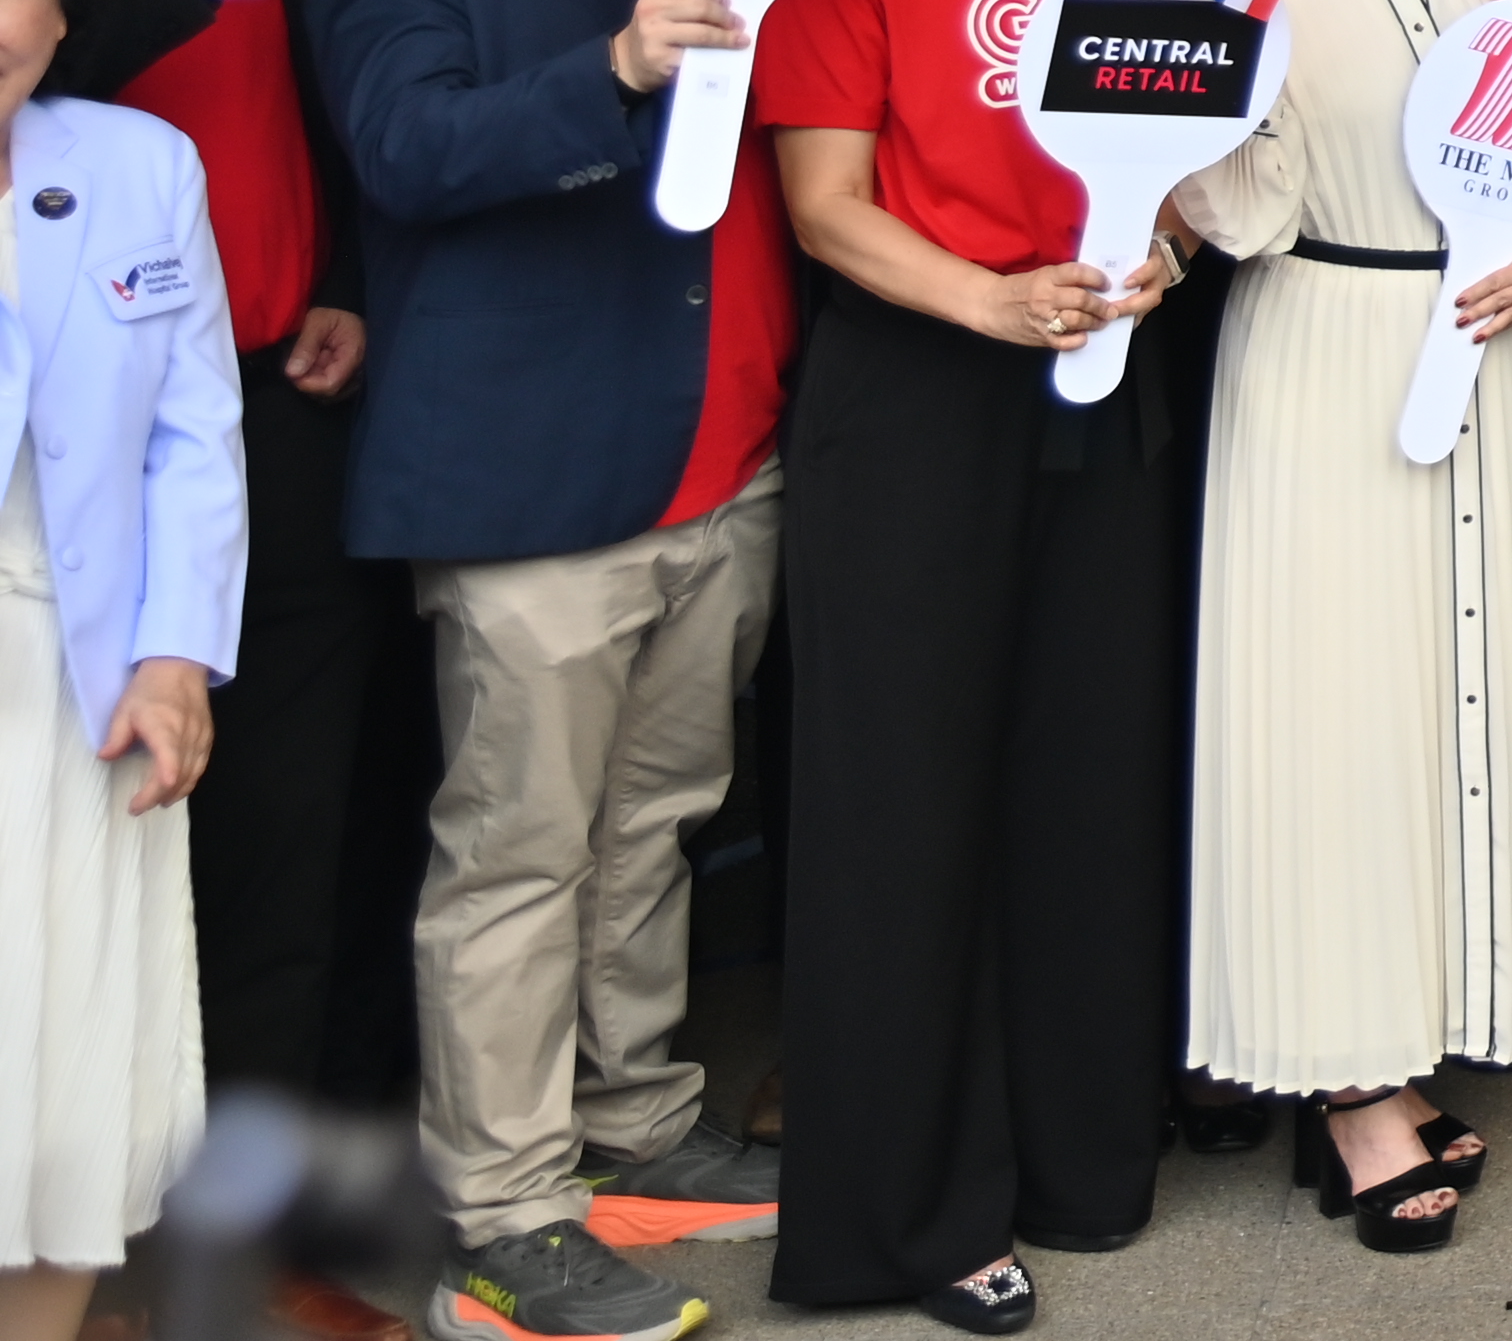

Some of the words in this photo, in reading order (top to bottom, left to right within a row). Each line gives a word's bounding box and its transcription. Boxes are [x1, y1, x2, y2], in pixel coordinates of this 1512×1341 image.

[1078, 36, 1235, 66] CENTRAL
[1094, 66, 1208, 94] RETAIL
[1439, 141, 1494, 177] THE
[465, 1270, 518, 1320] HOKA
